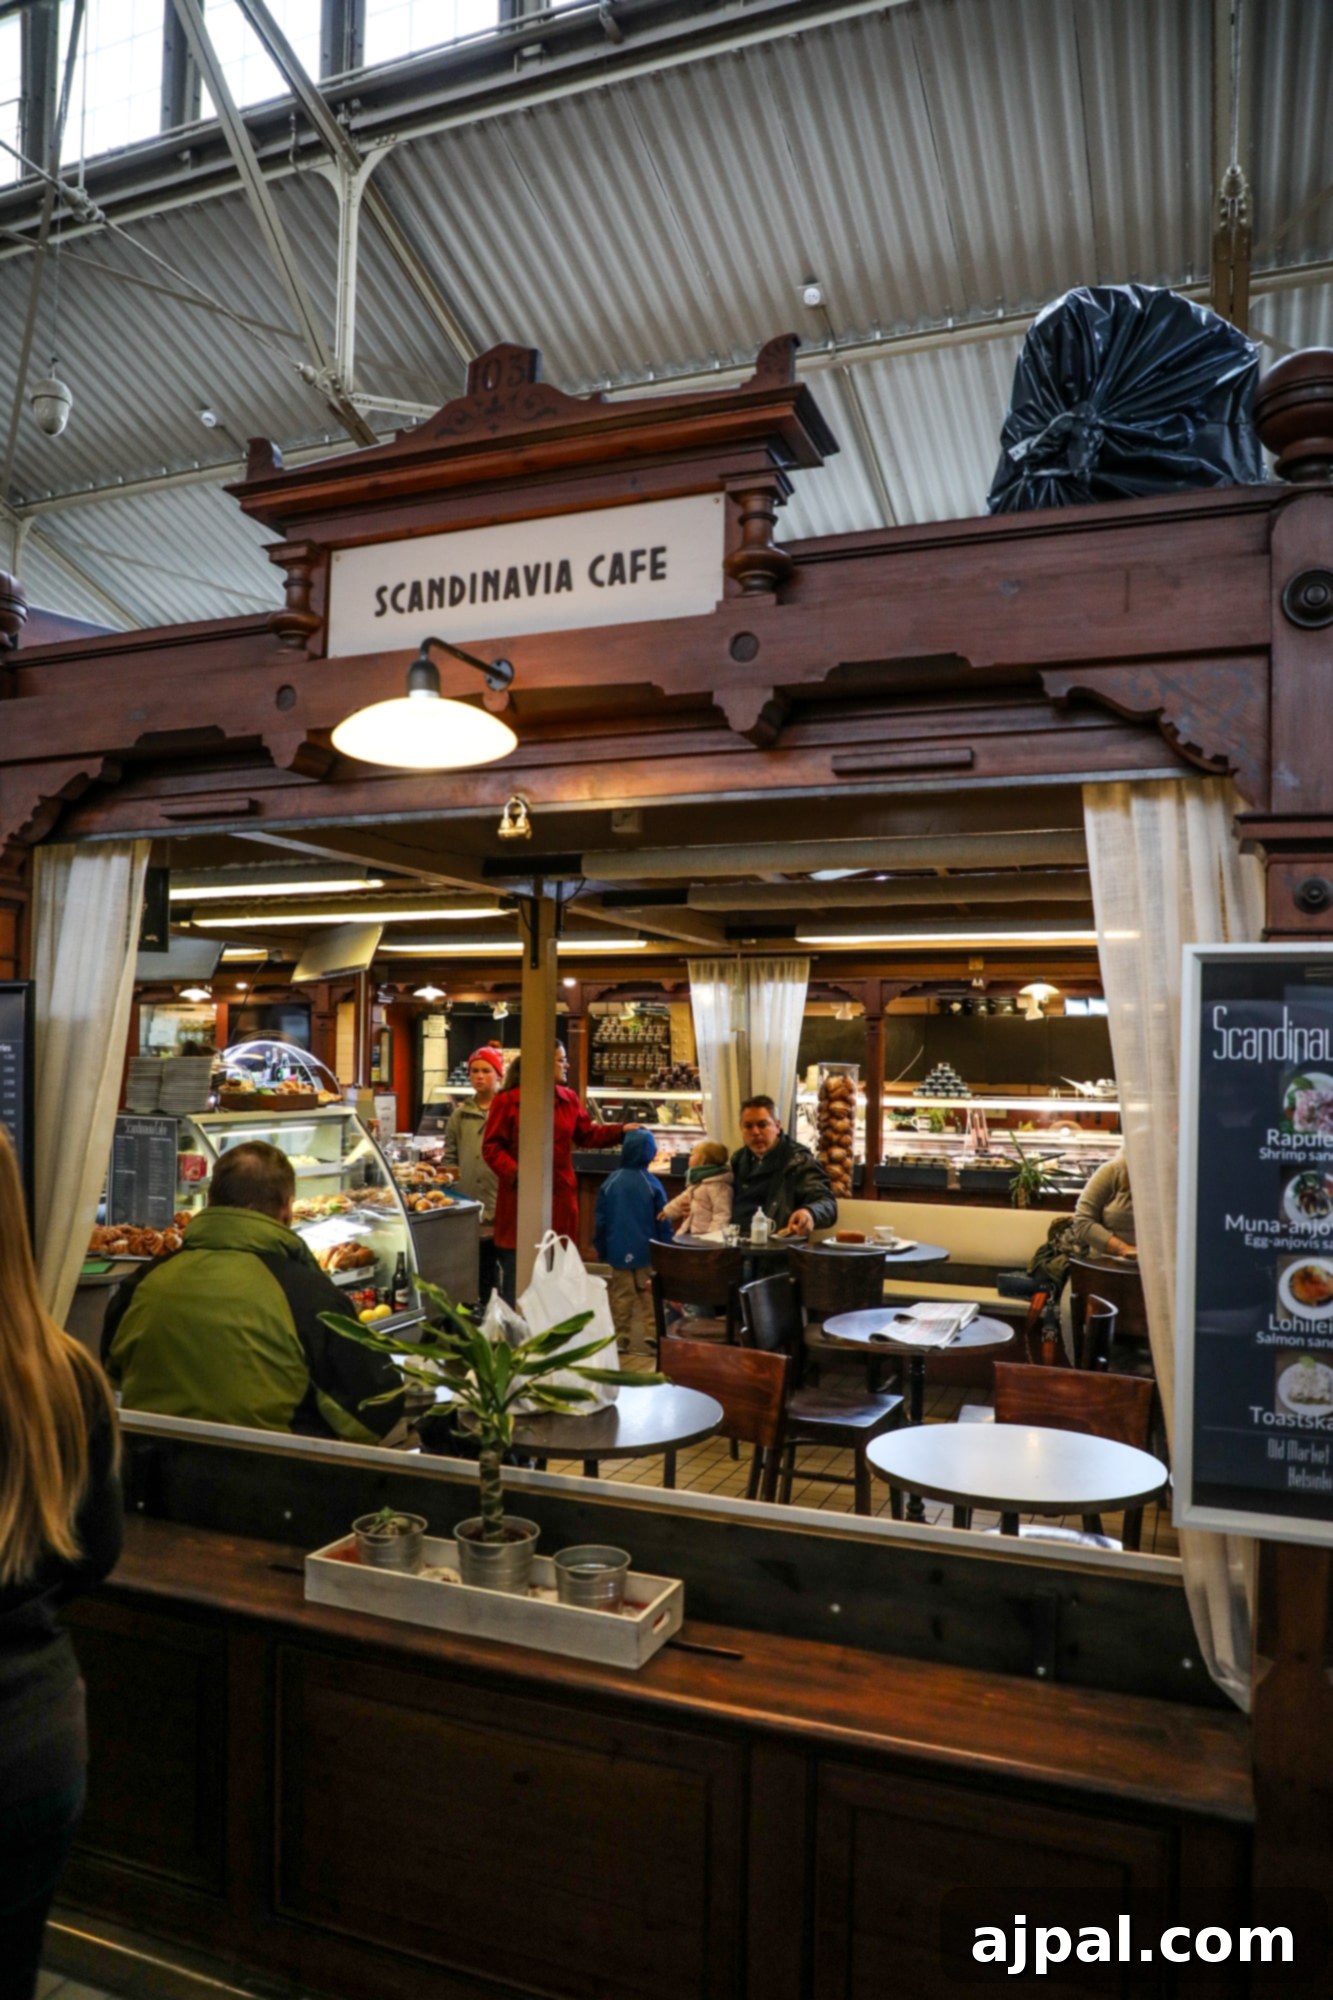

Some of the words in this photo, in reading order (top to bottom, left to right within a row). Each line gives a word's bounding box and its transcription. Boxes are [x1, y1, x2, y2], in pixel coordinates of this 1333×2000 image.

[374, 559, 573, 617] SCANDINAVIA
[588, 546, 667, 588] CAFE
[1259, 1147, 1306, 1162] Shrimp
[1225, 1214, 1333, 1239] Muna-anjo
[1244, 1233, 1319, 1250] Egg-anjovis
[1256, 1331, 1304, 1346] Salmon
[1267, 1438, 1285, 1459] Old
[1288, 1466, 1333, 1489] Helsinki
